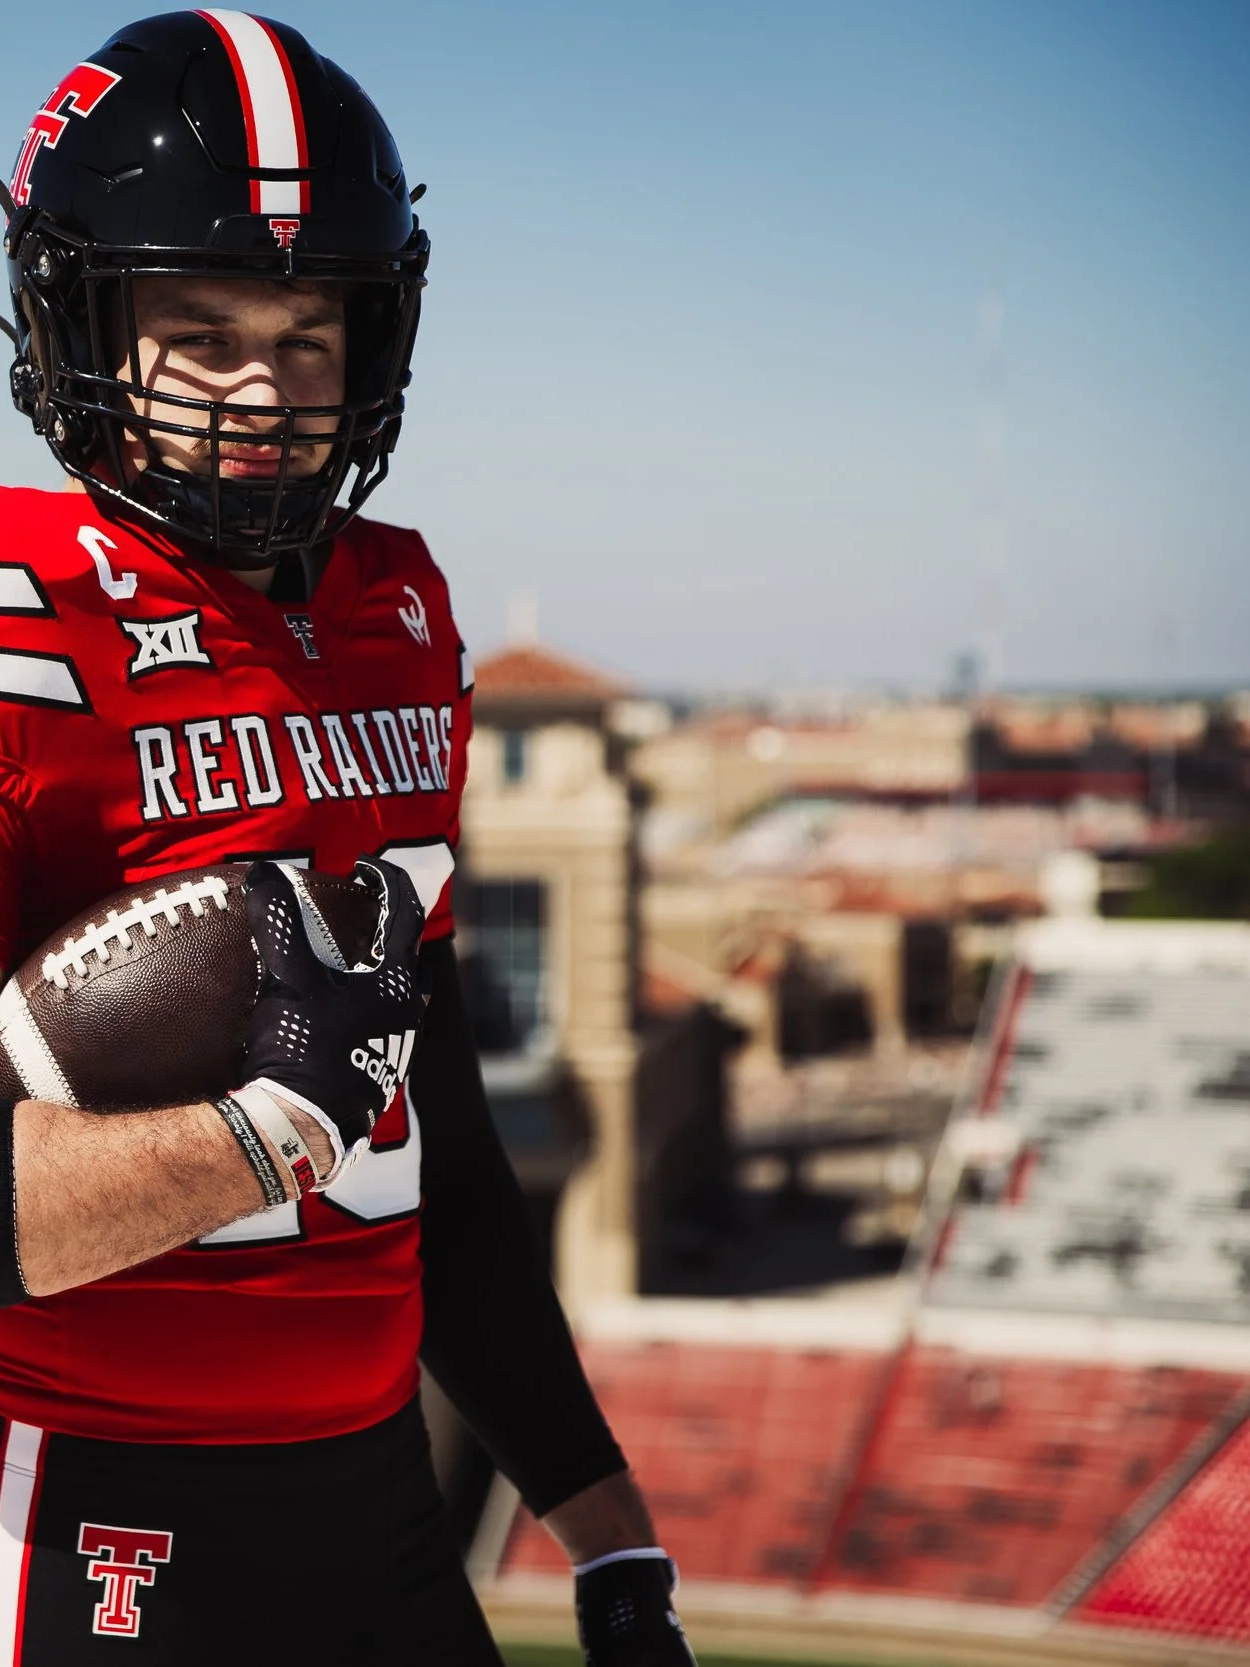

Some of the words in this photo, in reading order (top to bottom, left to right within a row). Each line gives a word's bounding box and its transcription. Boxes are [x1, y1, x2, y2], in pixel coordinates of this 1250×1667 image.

[76, 524, 138, 601] C
[120, 612, 212, 676] XII
[133, 713, 285, 822] RED
[284, 704, 453, 802] RAIDERS
